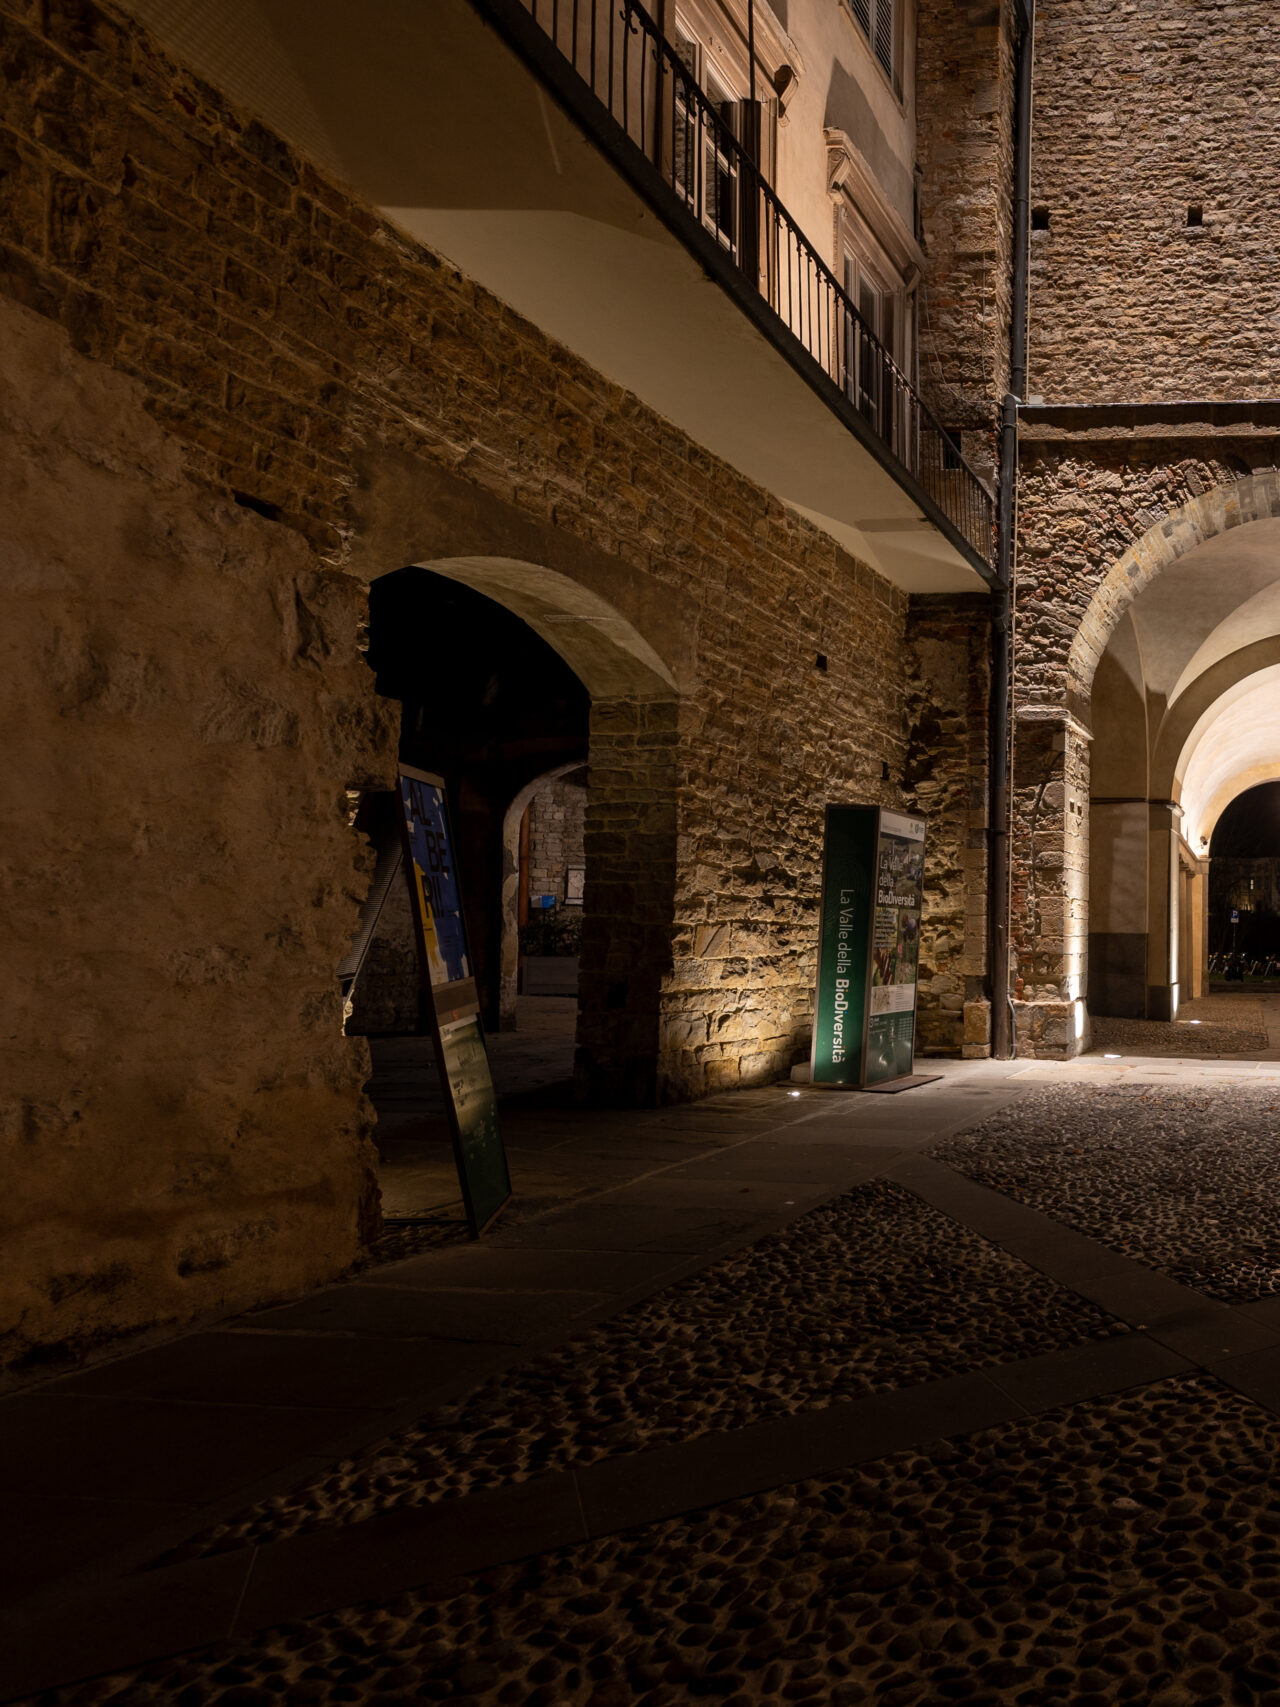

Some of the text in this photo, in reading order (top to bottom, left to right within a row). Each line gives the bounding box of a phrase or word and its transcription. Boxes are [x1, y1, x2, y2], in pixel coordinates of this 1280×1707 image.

[879, 874, 894, 887] della
[878, 889, 915, 907] BioDiversità
[831, 888, 855, 1064] La Valle della BioDiversità
